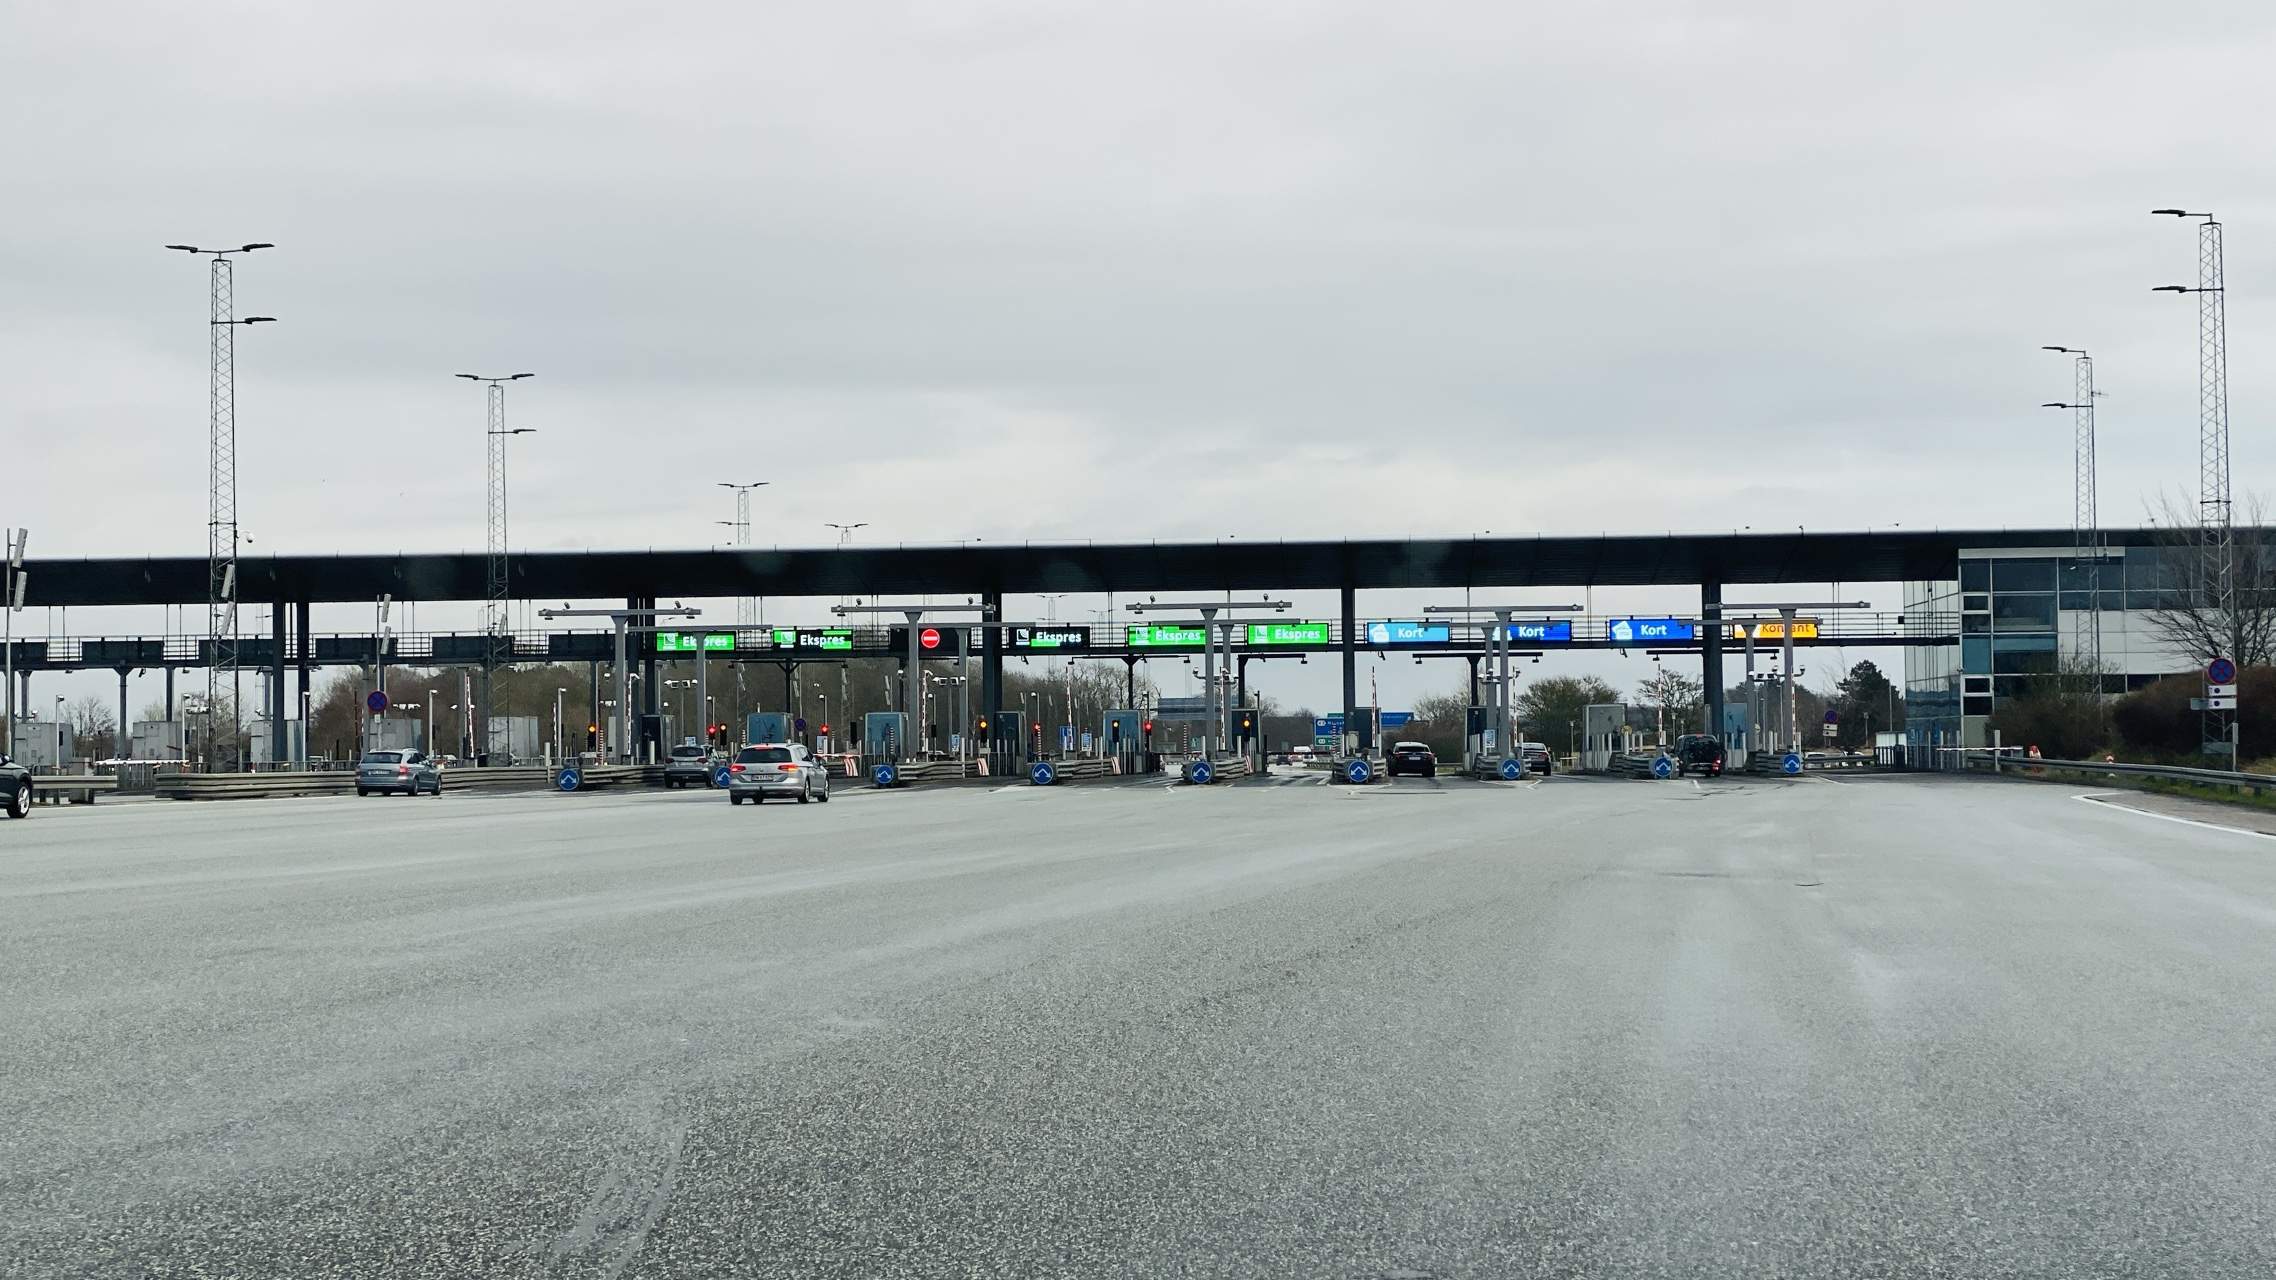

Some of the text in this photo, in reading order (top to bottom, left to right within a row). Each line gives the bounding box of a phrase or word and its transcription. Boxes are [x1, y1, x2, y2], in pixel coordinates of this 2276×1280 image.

[1398, 628, 1424, 639] Kort
[1519, 626, 1545, 637] Kort
[1641, 624, 1667, 635] Kort
[1762, 623, 1811, 633] Konant
[1036, 632, 1081, 643] Ekspres
[1155, 630, 1201, 642] Ekspres
[1275, 628, 1320, 641] Ekspres
[683, 635, 727, 648] Ekpres
[800, 634, 845, 647] Ekspres
